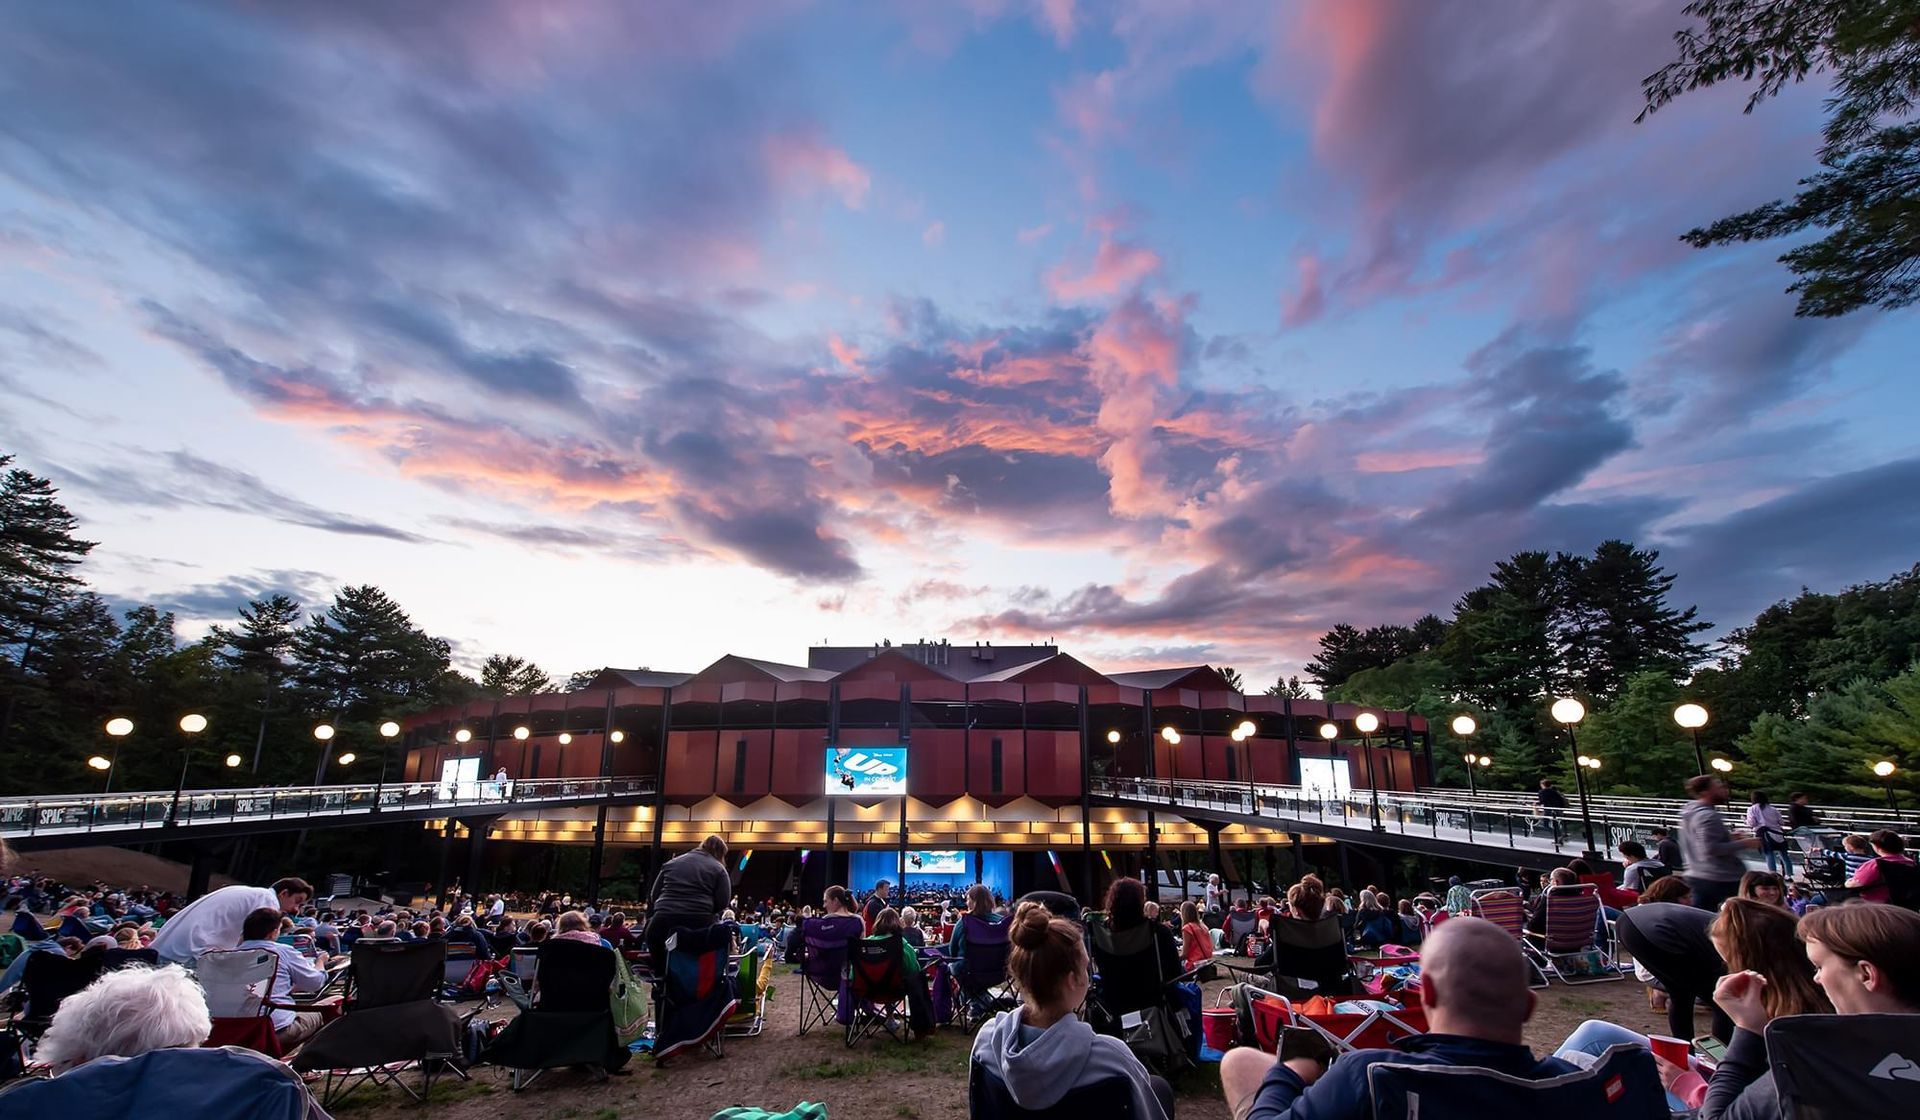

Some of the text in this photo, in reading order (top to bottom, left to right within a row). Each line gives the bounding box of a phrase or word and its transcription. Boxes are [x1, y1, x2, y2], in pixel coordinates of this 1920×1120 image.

[844, 753, 898, 775] UP
[237, 799, 254, 812] SPAC
[40, 808, 63, 824] SPAC
[1435, 811, 1450, 828] SPAC
[1610, 826, 1633, 846] SPAC
